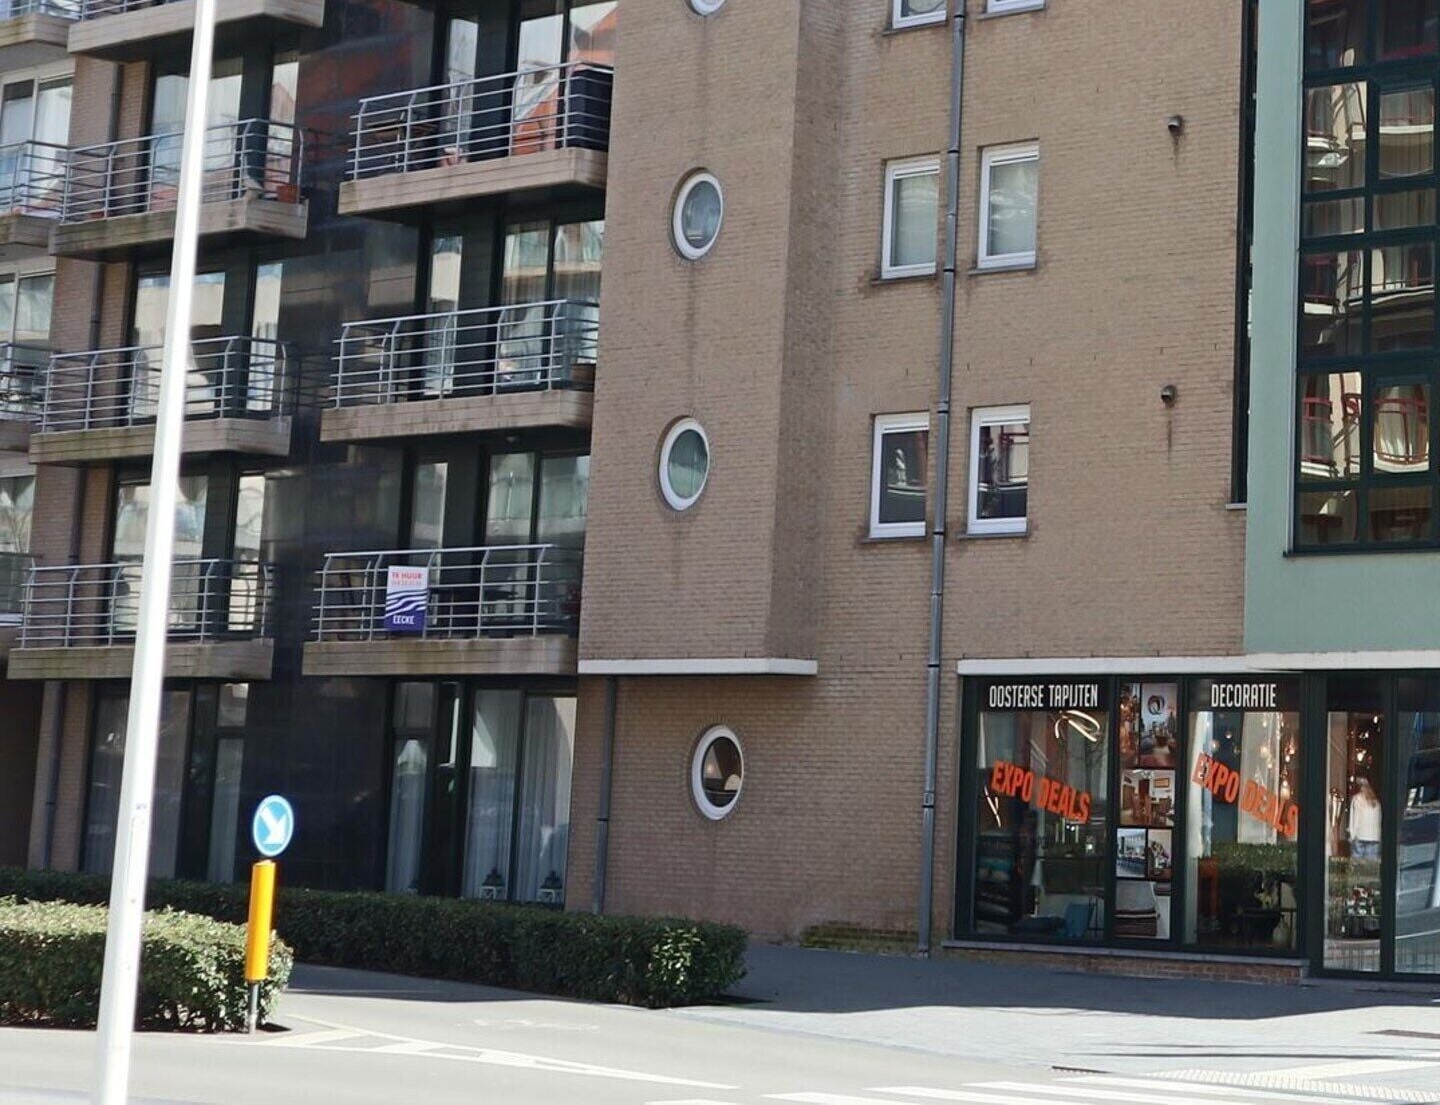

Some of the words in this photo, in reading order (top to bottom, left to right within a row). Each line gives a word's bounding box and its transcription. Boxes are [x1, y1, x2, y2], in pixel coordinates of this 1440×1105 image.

[989, 684, 1044, 708] OOSTERSE
[1048, 683, 1098, 708] TAPIJTEN
[1211, 683, 1276, 709] DECORATIE
[991, 758, 1035, 803] EXPO
[1036, 777, 1092, 825] DEALS
[1191, 752, 1240, 803] EXPO
[1240, 778, 1299, 838] DEALS
